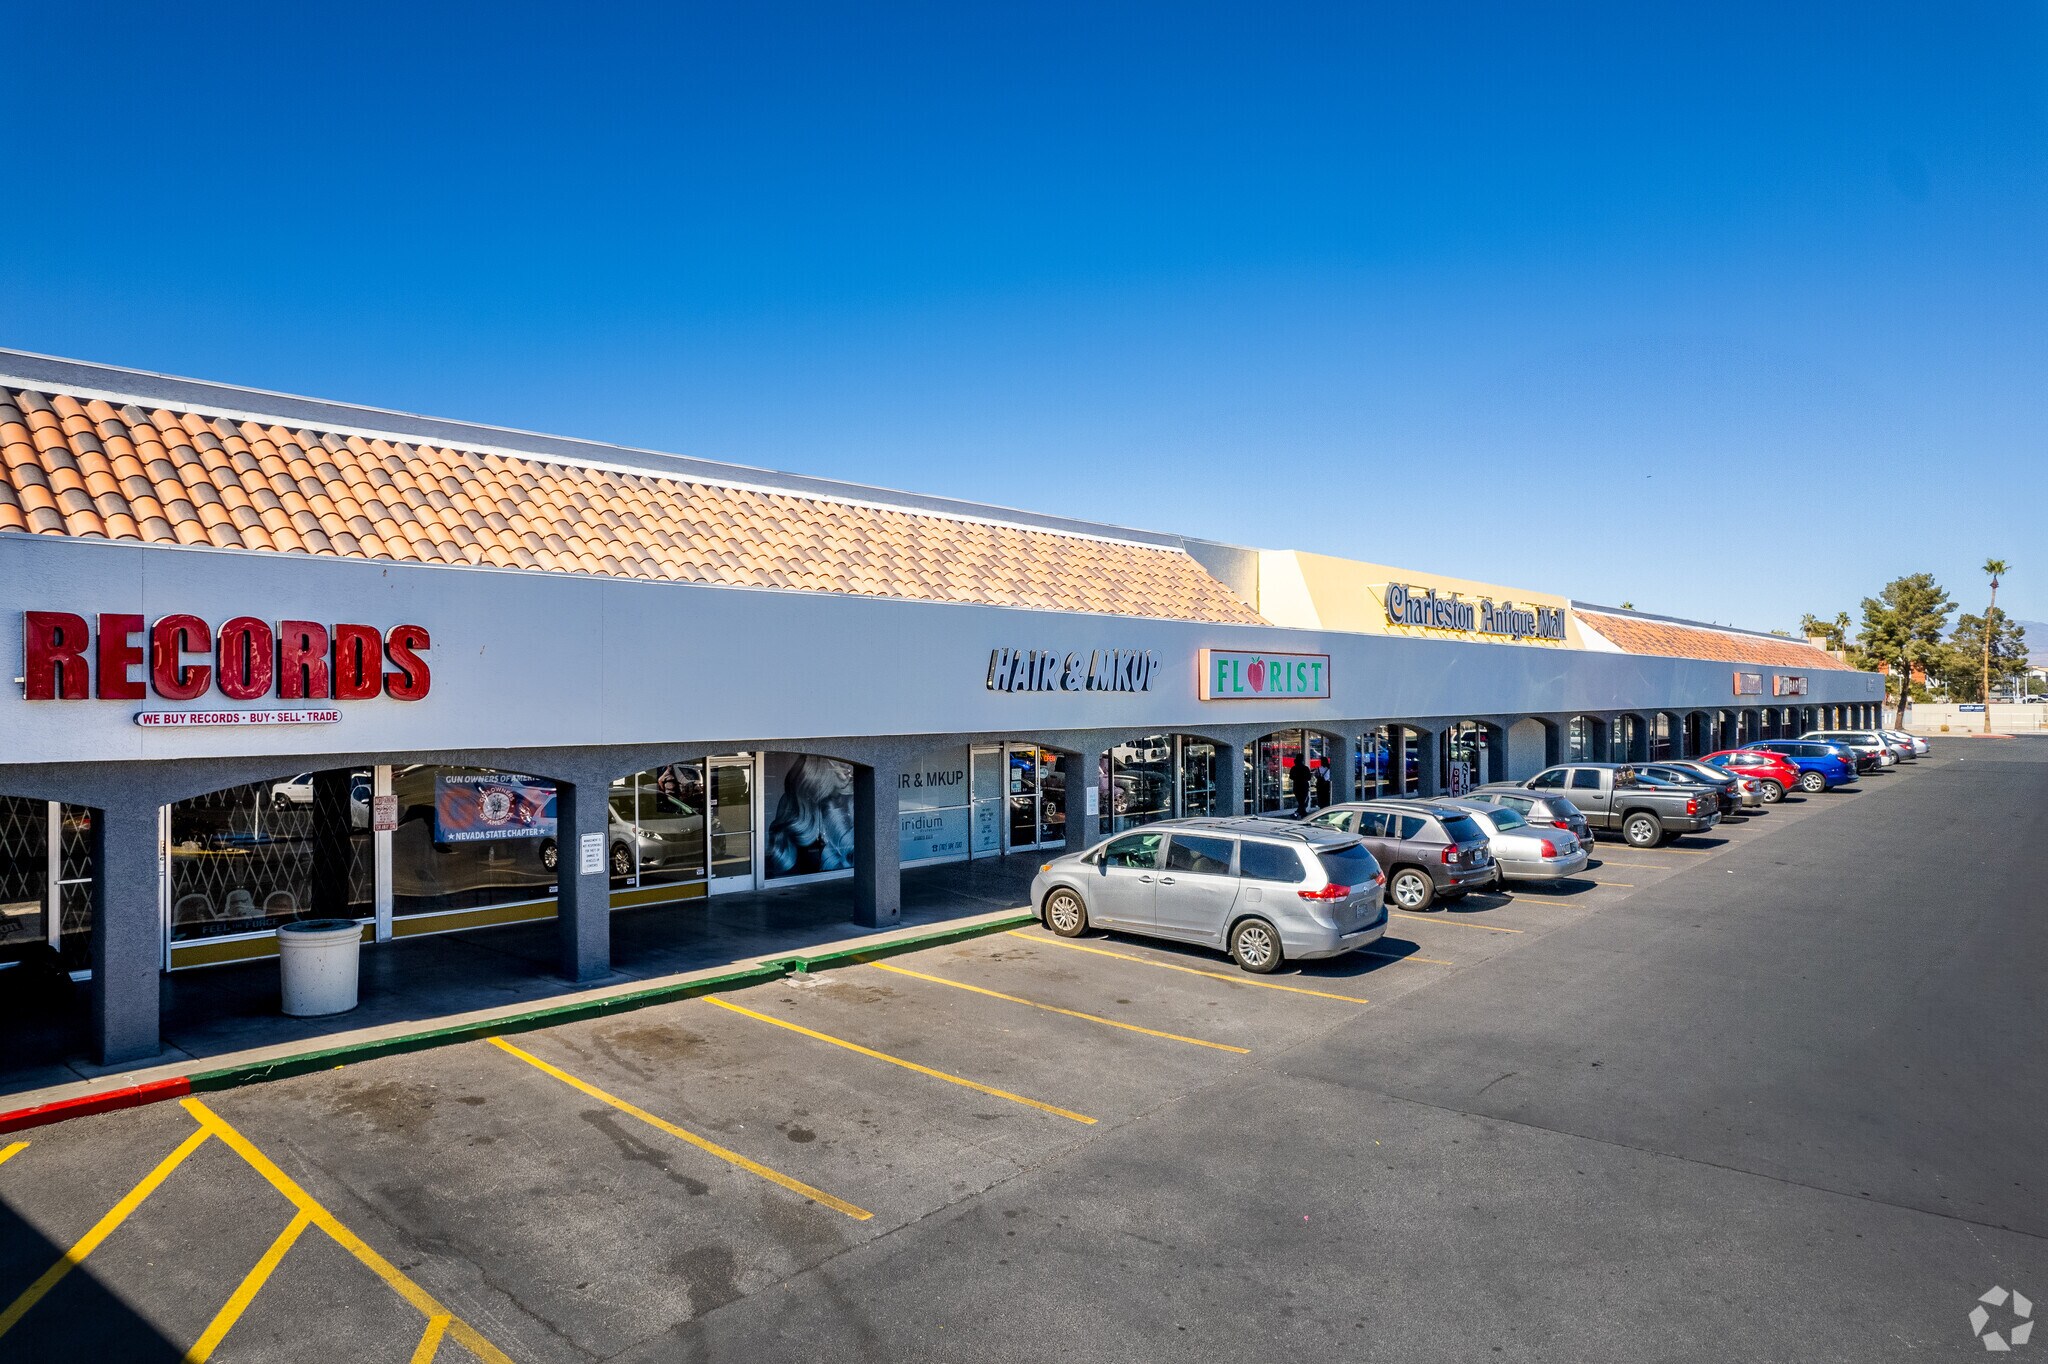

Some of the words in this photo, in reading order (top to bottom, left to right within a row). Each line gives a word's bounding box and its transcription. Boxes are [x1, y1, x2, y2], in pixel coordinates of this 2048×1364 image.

[1385, 583, 1475, 632] Charleston
[1480, 600, 1535, 640] Antique
[1536, 606, 1567, 640] Mall
[22, 610, 431, 701] RECORDS
[986, 648, 1061, 692] HAIR
[1061, 651, 1086, 692] &
[1086, 648, 1163, 692] MKUP
[143, 714, 160, 724] WE
[163, 714, 186, 724] BUY
[189, 713, 240, 723] RECORDS
[250, 713, 270, 722] BUY
[277, 713, 300, 722] SELL
[307, 711, 338, 721] TRADE
[446, 776, 463, 784] GUN
[464, 774, 498, 784] OWNERS
[898, 774, 910, 788] IR
[914, 772, 923, 788] &
[926, 770, 964, 786] MKUP
[902, 816, 943, 831] iridium
[456, 831, 485, 841] NEVADA
[486, 830, 506, 840] STATE
[507, 828, 538, 837] CHAPTER
[202, 924, 231, 934] FEEL
